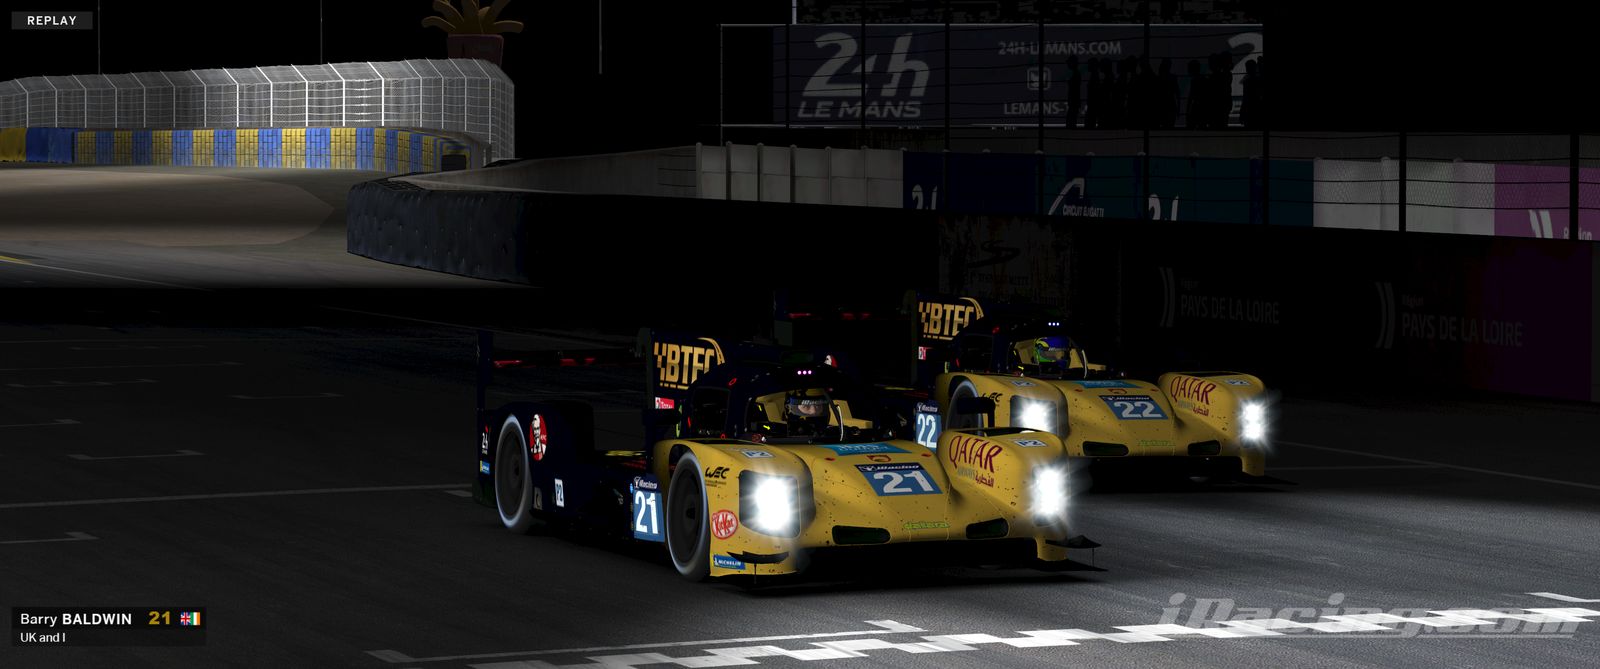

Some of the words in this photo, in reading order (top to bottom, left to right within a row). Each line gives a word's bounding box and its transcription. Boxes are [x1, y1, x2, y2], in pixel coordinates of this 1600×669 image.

[801, 31, 931, 98] 24h
[797, 102, 832, 118] LE
[838, 101, 922, 119] MANS
[1180, 294, 1208, 319] PAYS
[1211, 296, 1226, 320] DE
[1228, 296, 1244, 321] LA
[1246, 298, 1281, 325] LOIRE
[1401, 312, 1436, 339] PAYS
[1440, 315, 1457, 341] DE
[1461, 316, 1480, 344] LA
[1482, 319, 1524, 348] LOIRE
[1170, 375, 1216, 405] QATAR
[1113, 401, 1163, 418] 22
[917, 413, 937, 448] 22
[949, 435, 1003, 473] QATAR
[705, 466, 730, 479] WEC
[873, 471, 935, 494] 21
[635, 491, 659, 534] 21
